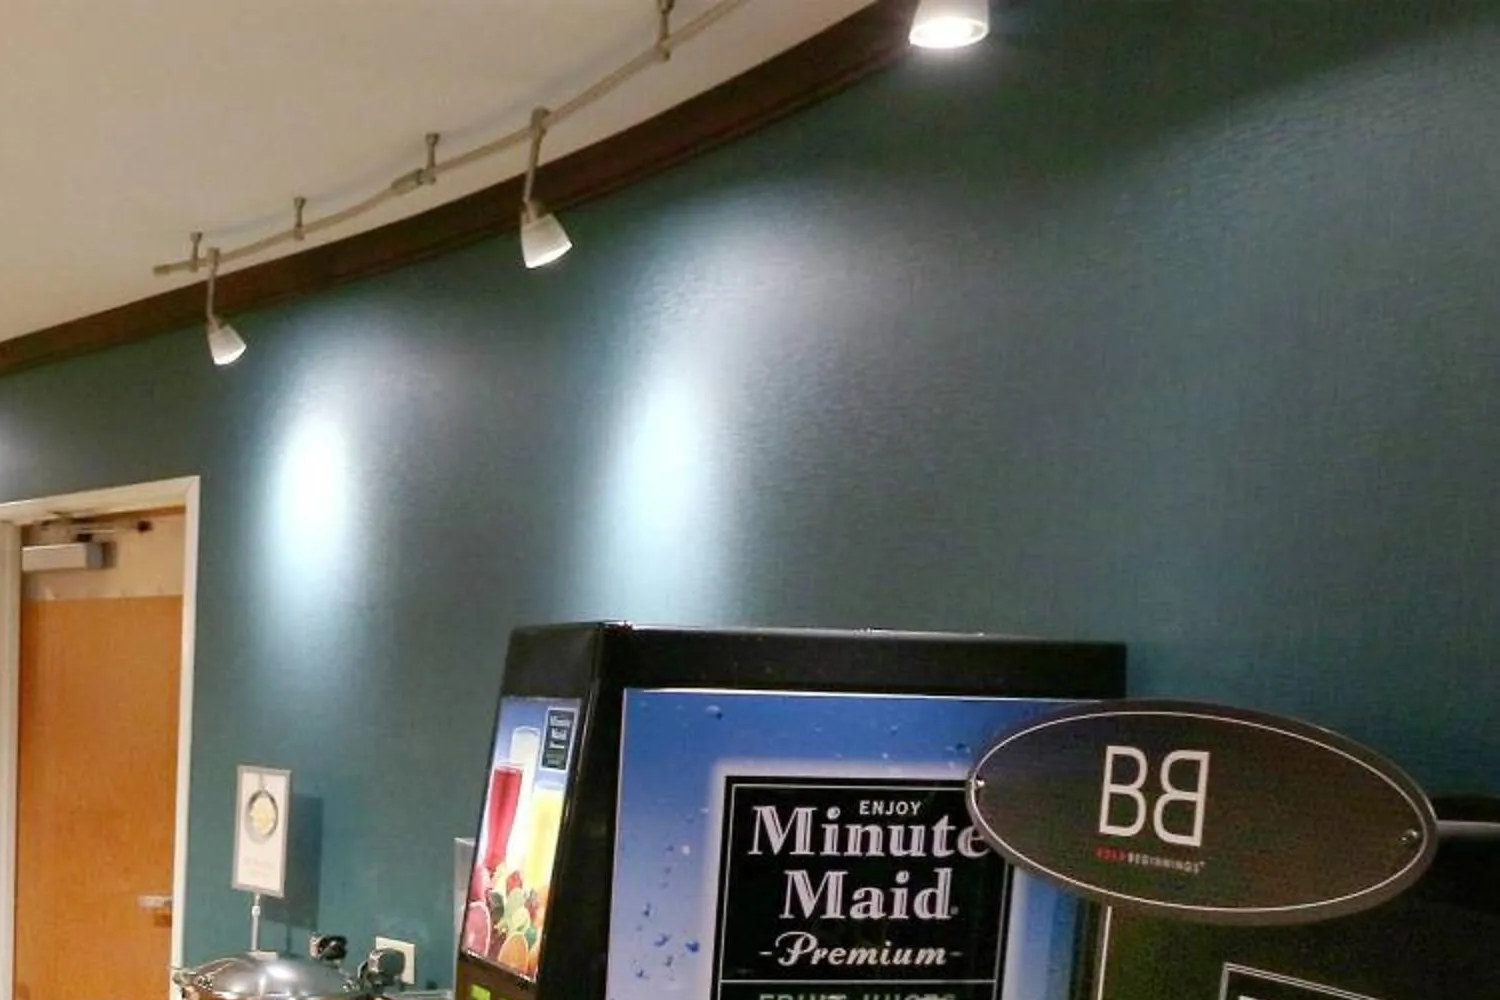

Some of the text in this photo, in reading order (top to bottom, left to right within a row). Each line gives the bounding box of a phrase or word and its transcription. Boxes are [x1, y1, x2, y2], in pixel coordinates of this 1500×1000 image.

[859, 800, 922, 816] ENJOY
[748, 804, 990, 859] Minute
[779, 868, 953, 920] Maid
[775, 931, 947, 967] Premium
